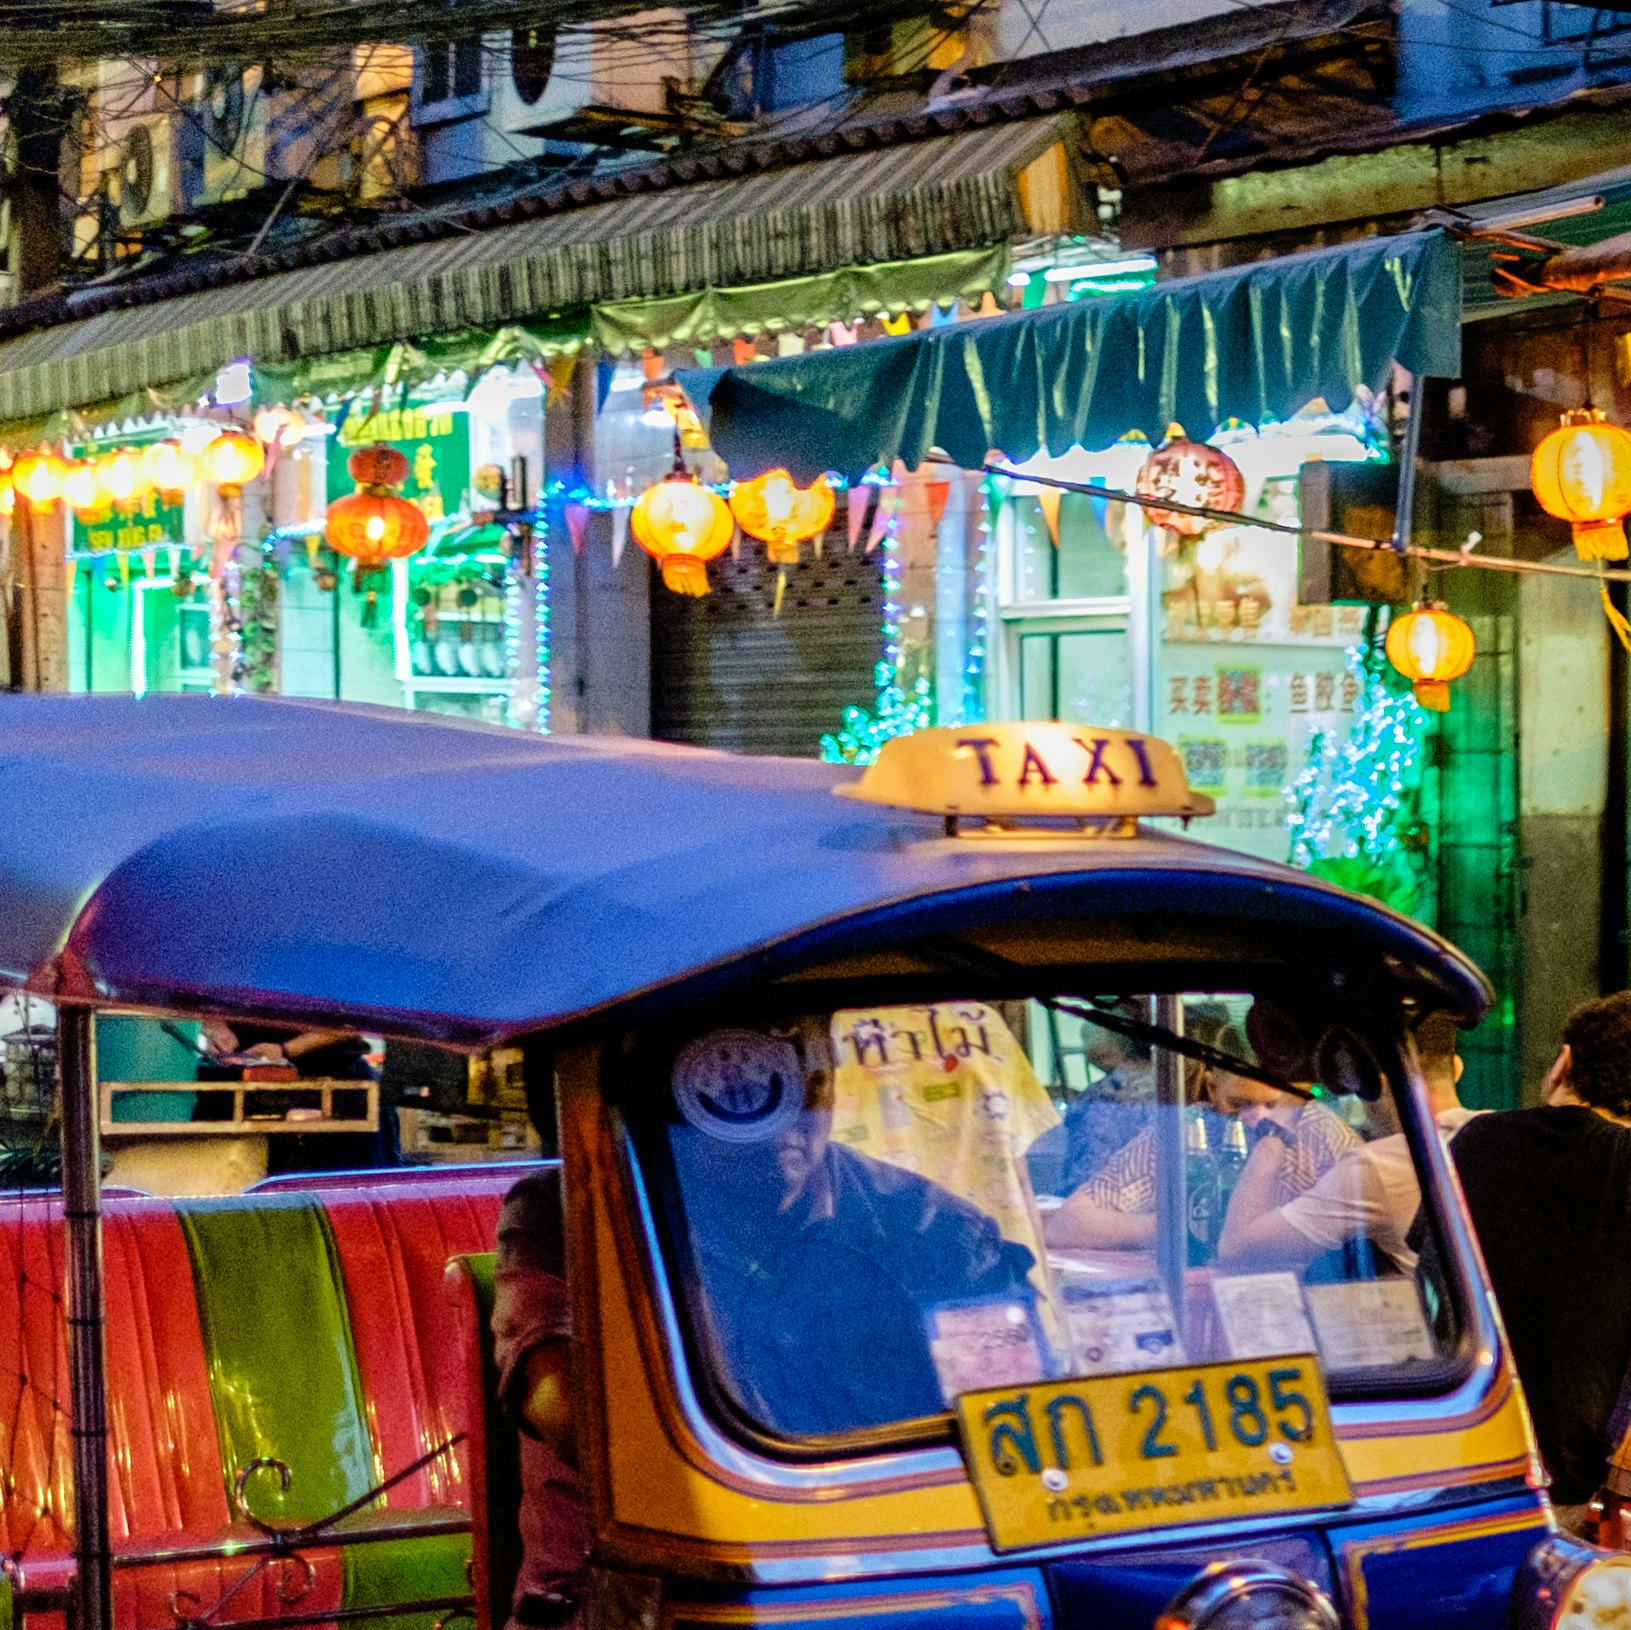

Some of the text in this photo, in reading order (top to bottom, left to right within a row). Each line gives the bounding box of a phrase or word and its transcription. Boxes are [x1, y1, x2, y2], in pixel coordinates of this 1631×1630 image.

[955, 737, 1159, 788] TAXI
[983, 1367, 1314, 1476] สก 2185
